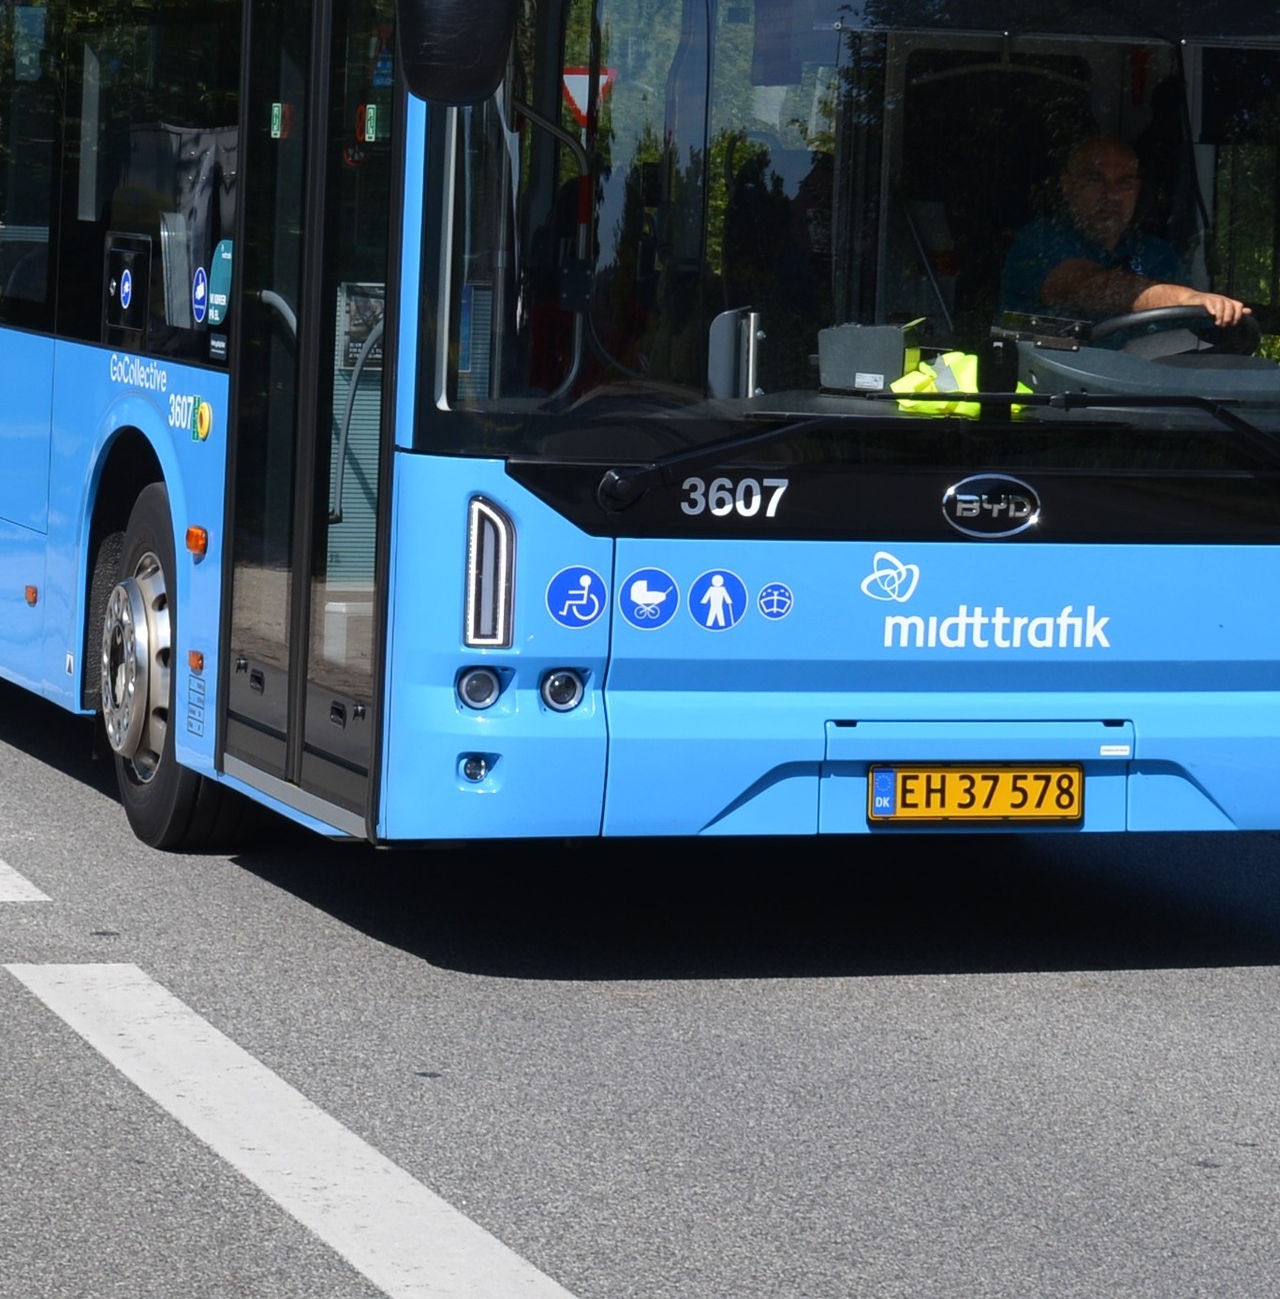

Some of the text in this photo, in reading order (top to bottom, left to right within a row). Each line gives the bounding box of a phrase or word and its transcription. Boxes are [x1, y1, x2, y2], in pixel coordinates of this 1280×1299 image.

[110, 353, 168, 392] GoCollective
[168, 393, 195, 431] 3607
[681, 478, 789, 518] 3607
[955, 494, 1032, 518] BYD
[884, 605, 1111, 648] midttrafik
[875, 796, 890, 808] DK
[900, 773, 1075, 810] EH 37 578
